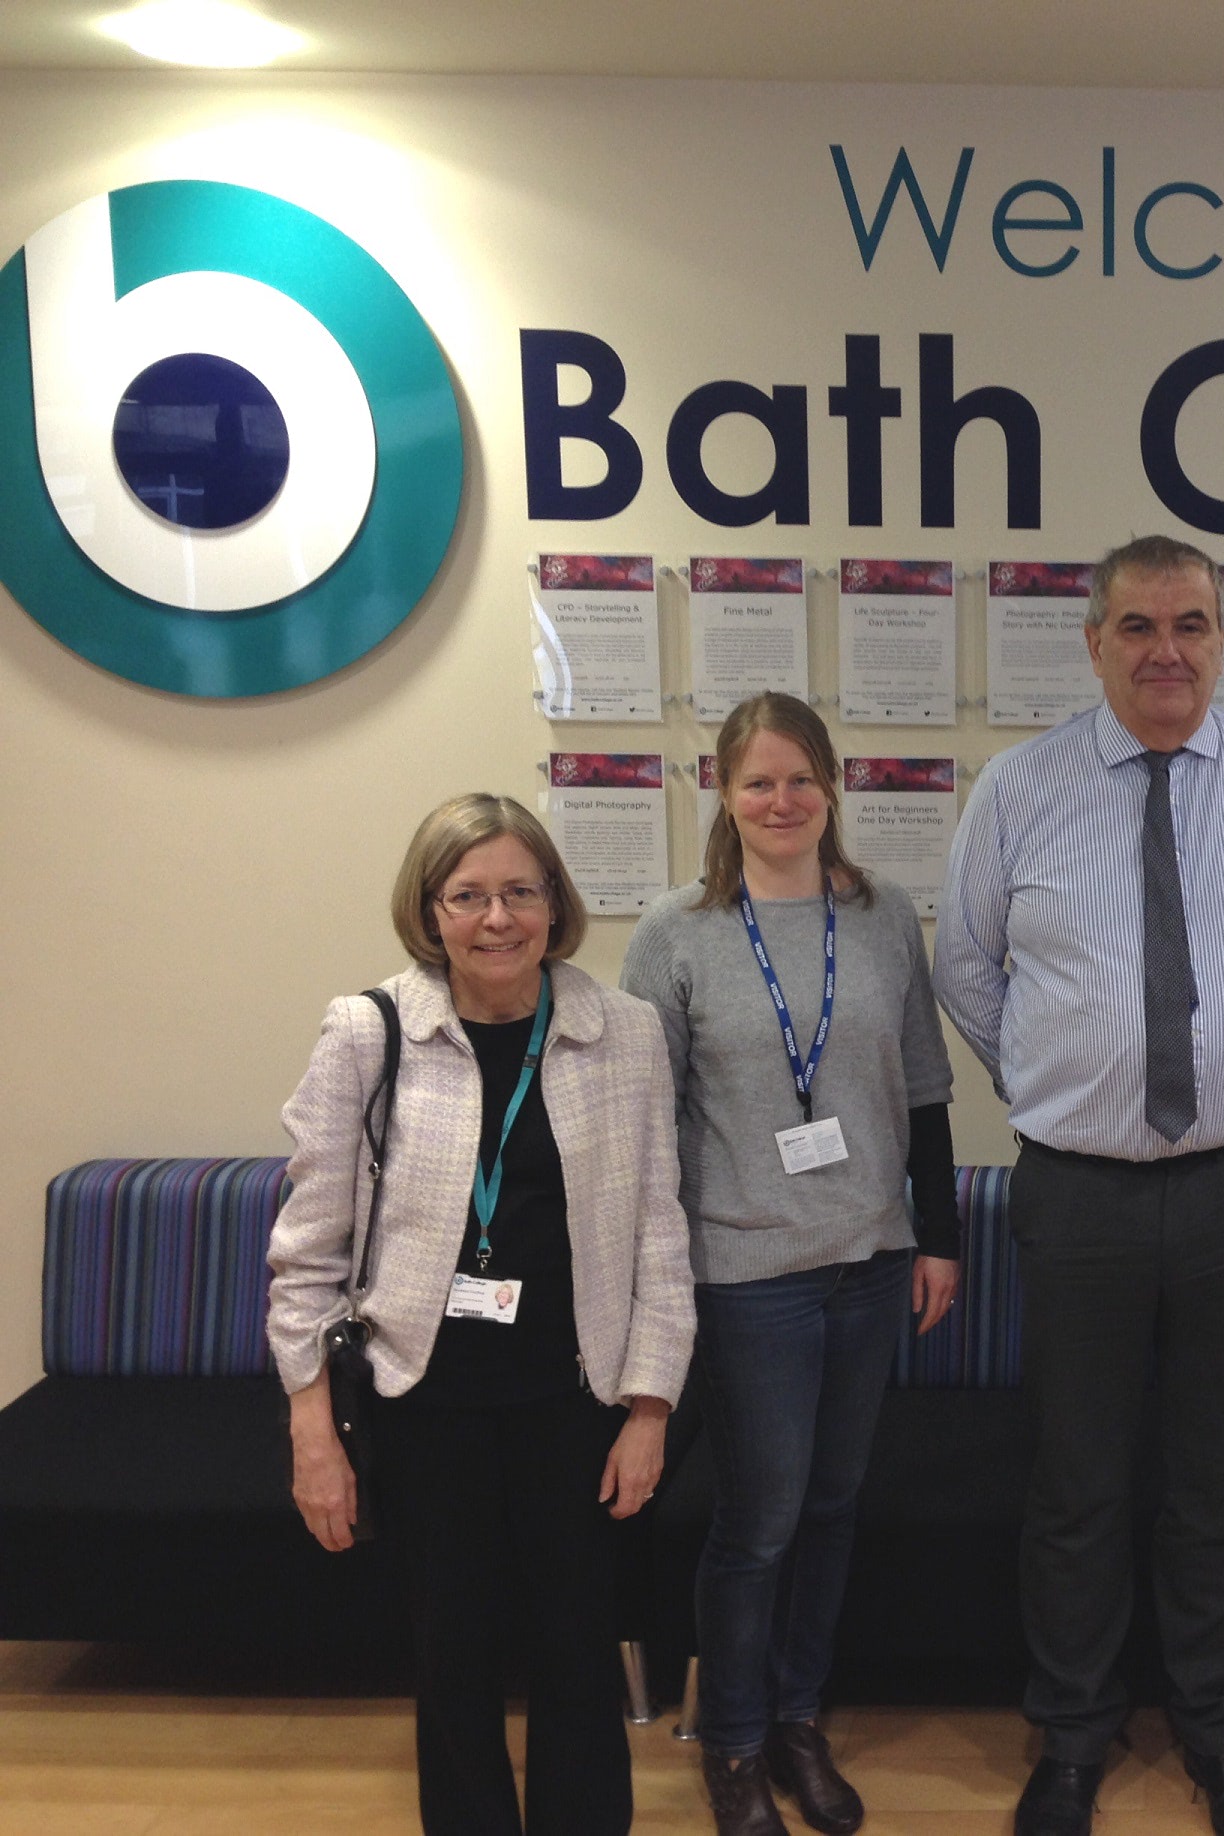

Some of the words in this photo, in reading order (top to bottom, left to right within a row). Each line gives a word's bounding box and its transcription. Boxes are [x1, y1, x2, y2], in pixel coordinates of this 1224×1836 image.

[520, 329, 1041, 530] Bath
[585, 604, 631, 613] Storytelling
[724, 606, 743, 616] Fine
[747, 607, 772, 616] Metal
[854, 608, 868, 616] Life
[871, 608, 909, 618] Sculpture
[555, 615, 586, 623] Literacy
[590, 615, 642, 624] Development
[868, 620, 883, 628] Day
[887, 620, 926, 629] Workshop
[1002, 621, 1023, 629] Story
[564, 801, 593, 811] Digital
[596, 801, 651, 811] Photography
[878, 805, 890, 813] for
[894, 806, 938, 815] Beginners
[878, 817, 896, 826] Day
[900, 816, 943, 825] Workshop
[742, 900, 754, 926] VISITOR
[755, 942, 768, 968] VISITOR
[771, 982, 784, 1009] VISITOR
[816, 1016, 828, 1045] VISITOR
[784, 1026, 797, 1057] VISITOR
